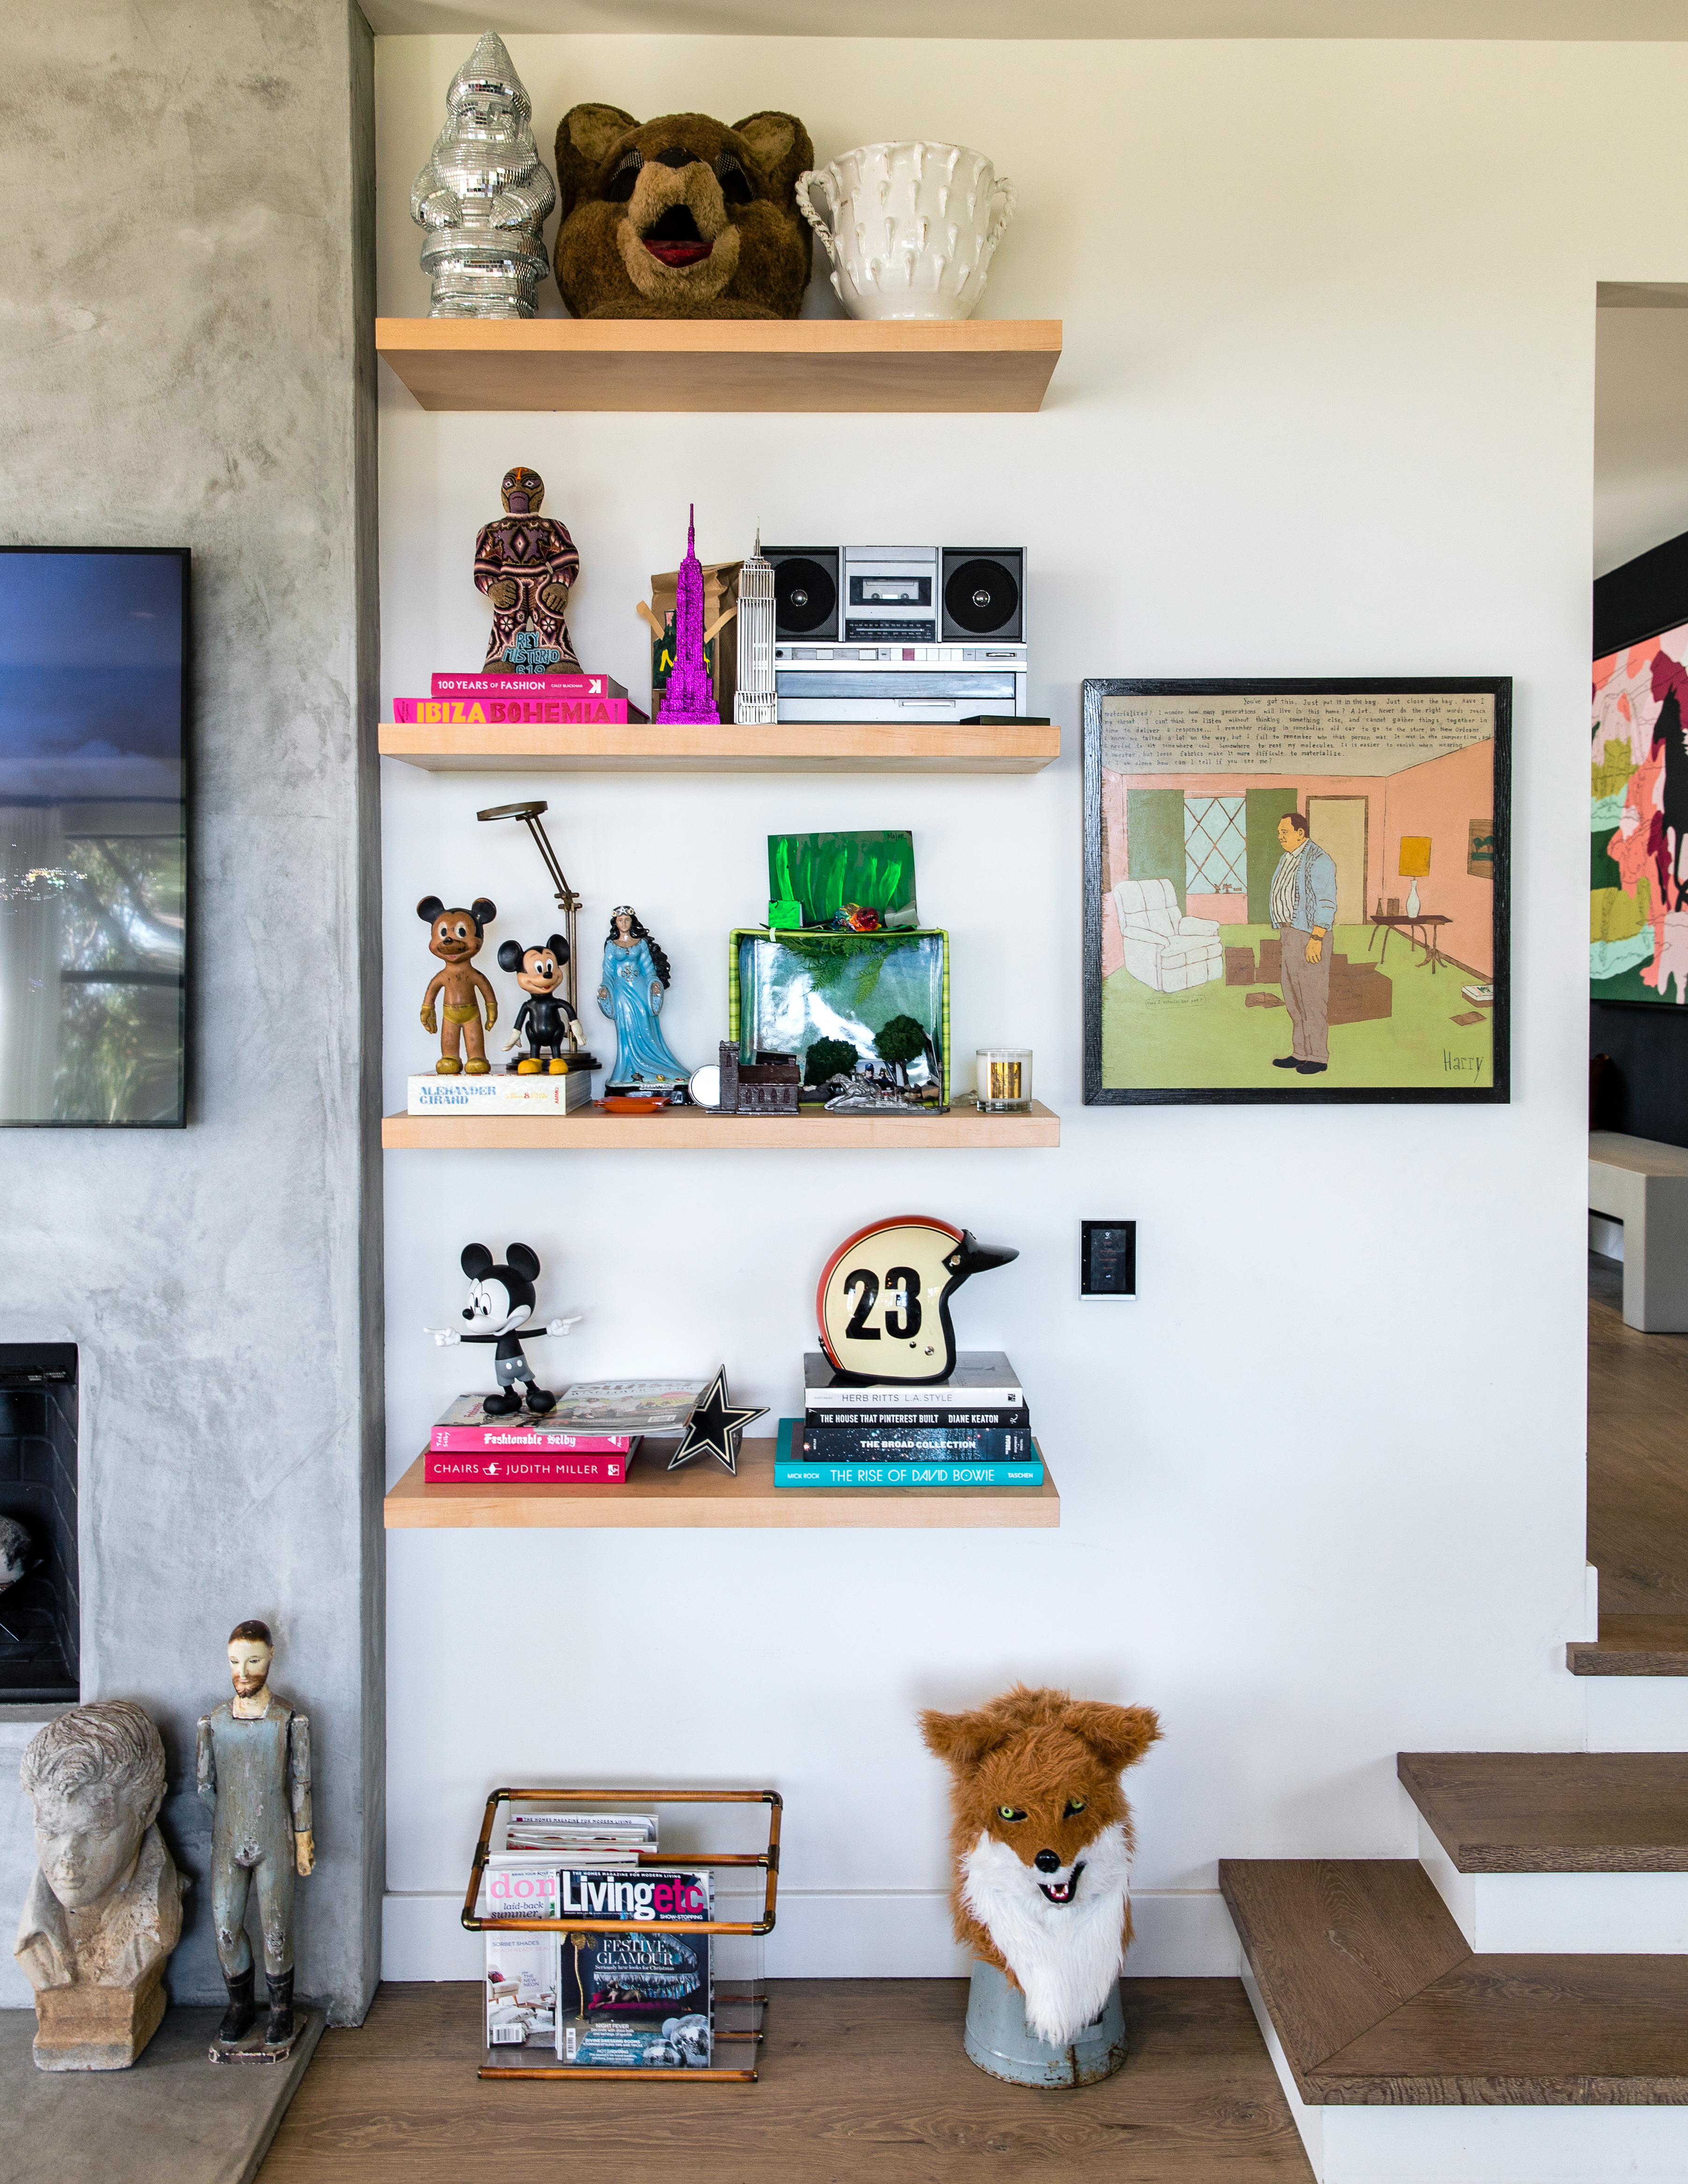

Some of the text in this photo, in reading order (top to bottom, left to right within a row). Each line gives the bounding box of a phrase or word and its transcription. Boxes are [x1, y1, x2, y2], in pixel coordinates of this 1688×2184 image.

[516, 631, 539, 648] REY
[502, 647, 560, 664] MISTERIO
[516, 664, 546, 674] 619
[437, 681, 455, 689] 100
[456, 681, 488, 690] YEARS
[501, 681, 546, 690] FASHION
[416, 702, 487, 723] IBIZA
[490, 702, 611, 723] BOHEMIA
[1443, 1048, 1484, 1083] Harry
[419, 1086, 496, 1096] ALEXANDER
[419, 1095, 469, 1104] GIRARD
[843, 1266, 922, 1340] 23
[820, 1415, 998, 1423] THE HOUSE THAT PINTEREST BUILT DIANE KEATON
[483, 1433, 576, 1447] Fashionable Selby
[916, 1441, 976, 1449] COLLECTION
[434, 1464, 598, 1474] CHAIRS JUDITH MILLER
[830, 1470, 852, 1481] THE
[858, 1470, 882, 1481] RISE
[888, 1470, 906, 1481] OF
[912, 1470, 948, 1481] DAVID
[953, 1470, 994, 1481] BOWIE
[604, 1940, 667, 1952] FESTIVE
[597, 1952, 674, 1965] GLAMOUR
